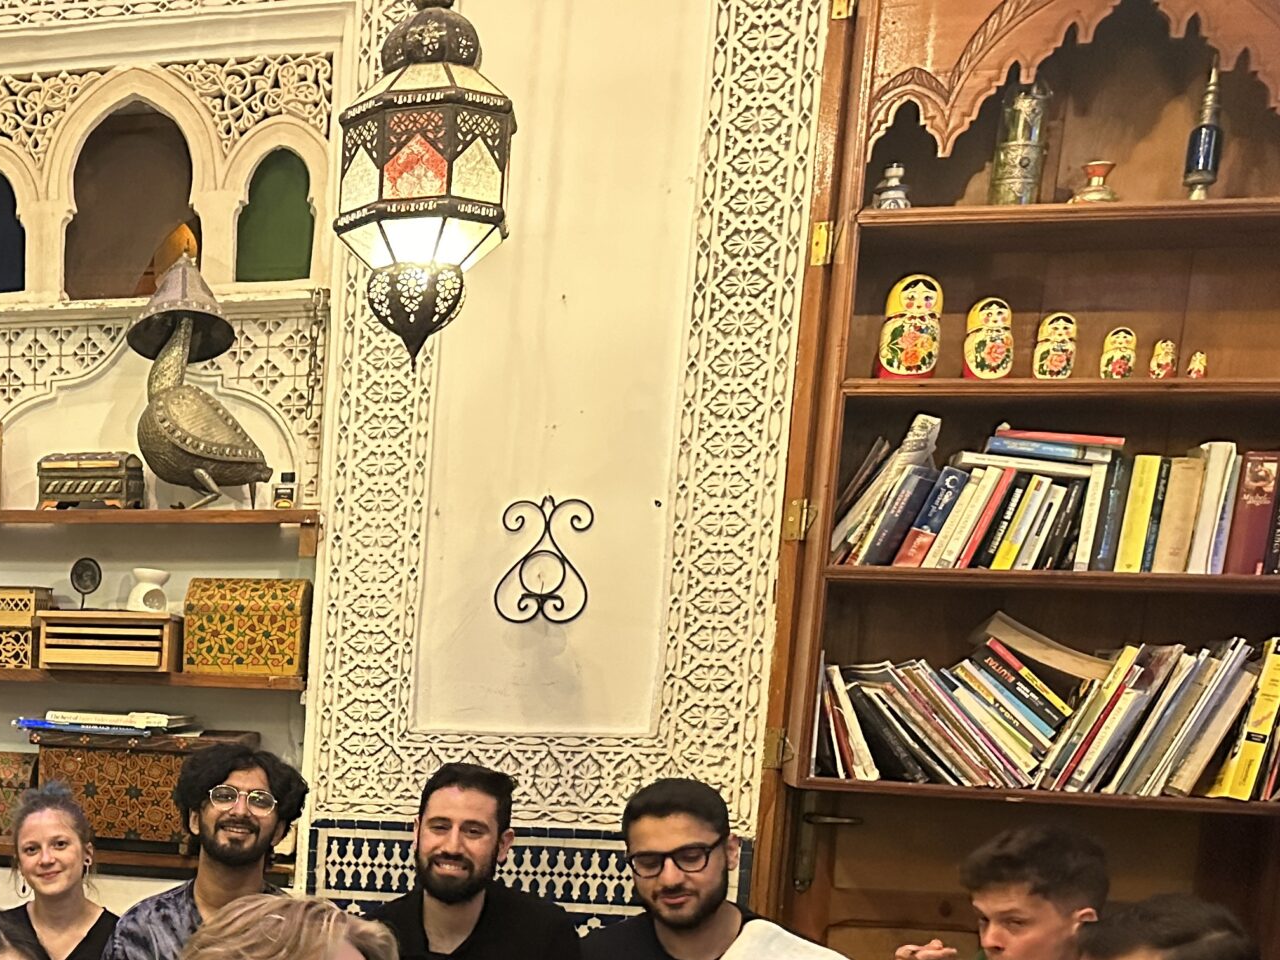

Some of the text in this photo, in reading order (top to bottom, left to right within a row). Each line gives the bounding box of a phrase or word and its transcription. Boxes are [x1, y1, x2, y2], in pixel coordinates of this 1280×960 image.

[894, 489, 912, 518] JOHANNA
[937, 490, 952, 510] Collins
[984, 657, 1015, 684] BLUTTAT
